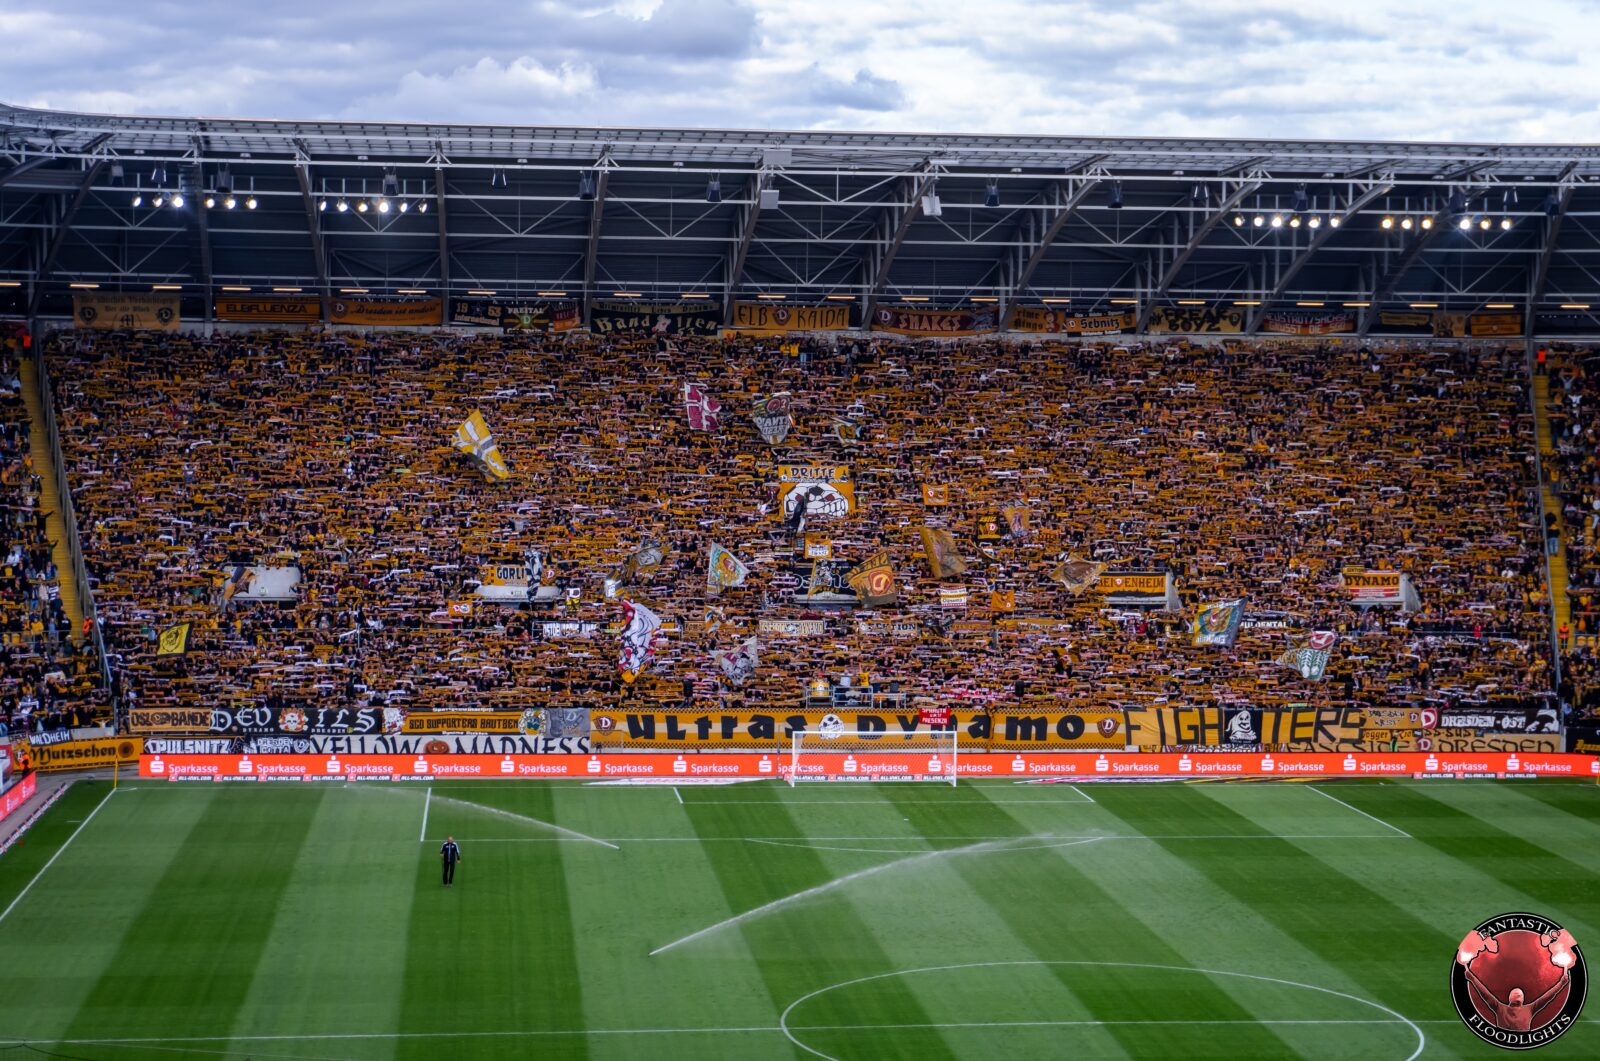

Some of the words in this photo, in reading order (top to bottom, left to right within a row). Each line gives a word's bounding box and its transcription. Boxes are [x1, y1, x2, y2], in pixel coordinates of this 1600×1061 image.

[226, 303, 307, 313] ELBFLUENZA
[738, 305, 768, 326] ELB
[797, 307, 846, 328] KAIDA
[898, 313, 961, 332] SNAKES
[1081, 318, 1120, 329] Sebnitz
[791, 467, 834, 478] DRITTE
[497, 567, 530, 580] GORLI
[1345, 576, 1399, 586] DYNAMO
[427, 718, 478, 729] SUPPORTERS
[29, 730, 71, 746] WALDHEIM
[257, 737, 293, 746] DRESDEN
[159, 739, 232, 754] PULSNITZ
[260, 746, 291, 754] COTTA
[31, 744, 117, 765] Mutzschen
[168, 763, 219, 775] Sparkasse
[256, 763, 306, 775] Sparkasse
[344, 763, 394, 775] Sparkasse
[431, 763, 481, 775] Sparkasse
[518, 763, 568, 775] Sparkasse
[604, 763, 654, 775] Sparkasse
[690, 763, 739, 775] Sparkasse
[860, 762, 909, 774] Sparkasse
[1029, 762, 1077, 774] Sparkasse
[1112, 762, 1160, 774] Sparkasse
[1195, 762, 1242, 774] Sparkasse
[1277, 761, 1325, 773] Sparkasse
[1359, 761, 1407, 773] Sparkasse
[1441, 761, 1488, 773] Sparkasse
[1523, 761, 1572, 773] Sparkasse
